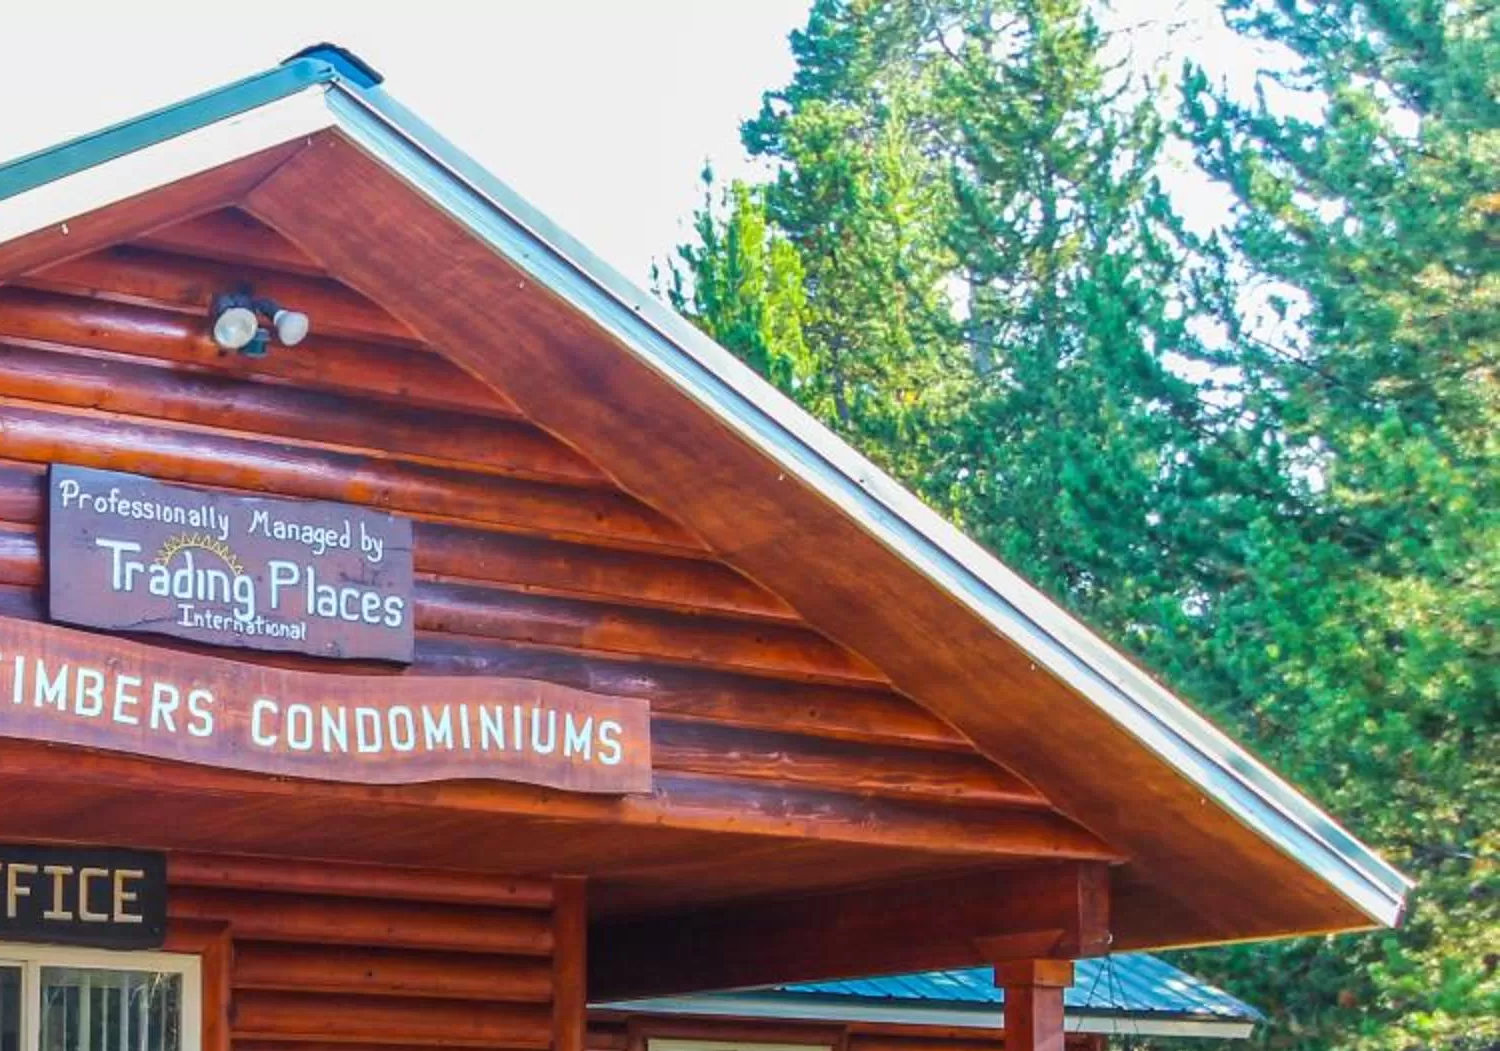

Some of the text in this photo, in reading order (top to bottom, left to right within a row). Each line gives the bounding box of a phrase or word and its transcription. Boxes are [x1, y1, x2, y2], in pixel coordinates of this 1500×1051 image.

[59, 479, 385, 562] Professionally Managed by
[95, 537, 404, 627] Trading Places
[177, 603, 308, 641] International
[250, 698, 622, 766] CONDOMINIUMS
